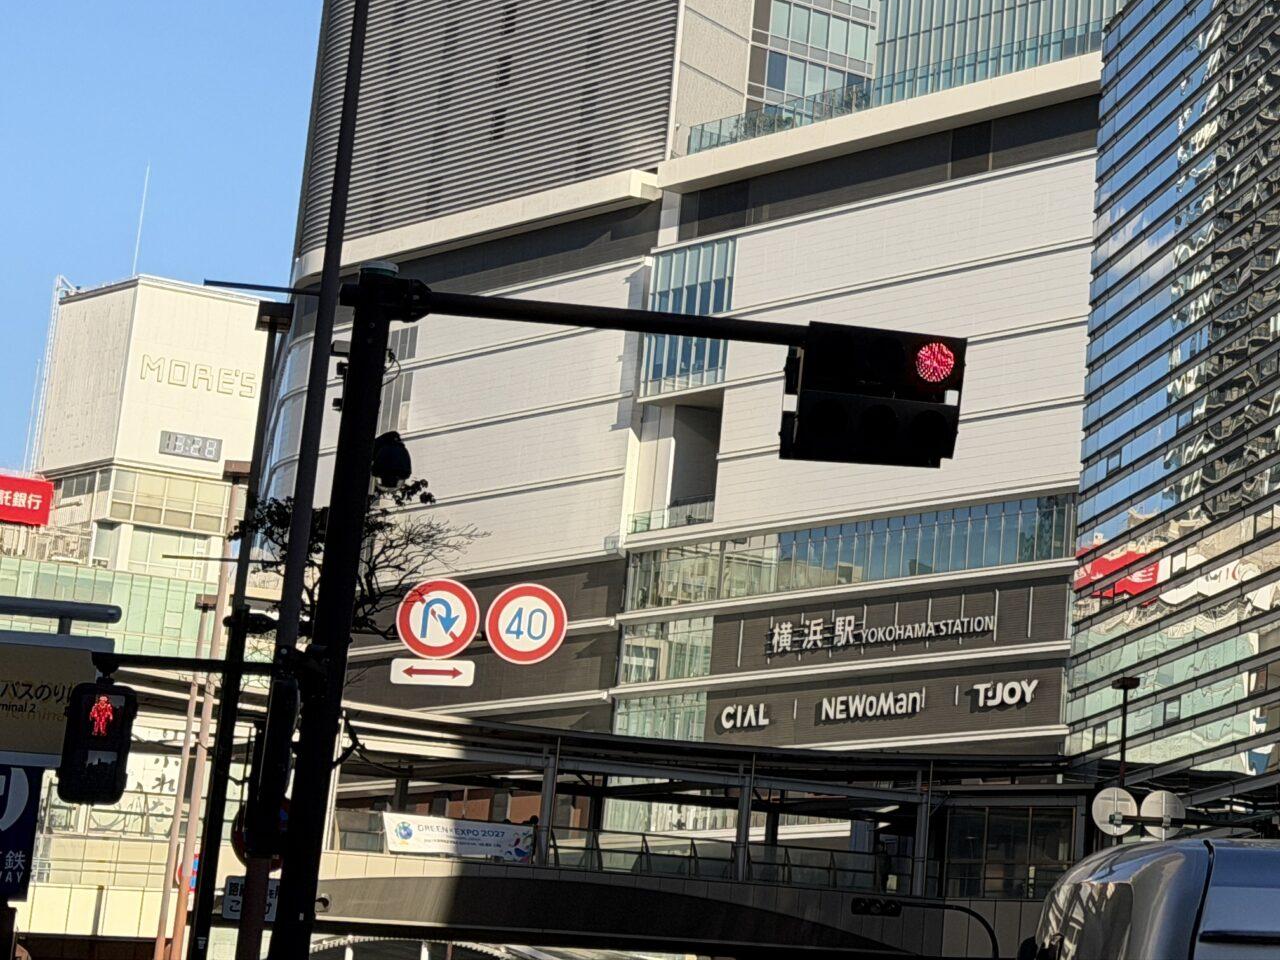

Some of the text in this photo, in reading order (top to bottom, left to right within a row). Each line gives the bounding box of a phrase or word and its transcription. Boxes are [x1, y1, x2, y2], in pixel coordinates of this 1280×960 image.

[140, 354, 257, 398] MORE'S
[505, 607, 547, 641] 40
[772, 615, 856, 653] 横浜駅
[861, 615, 994, 644] YOKOHAMA STATION
[721, 702, 770, 730] CIAL
[482, 829, 505, 838] 2027
